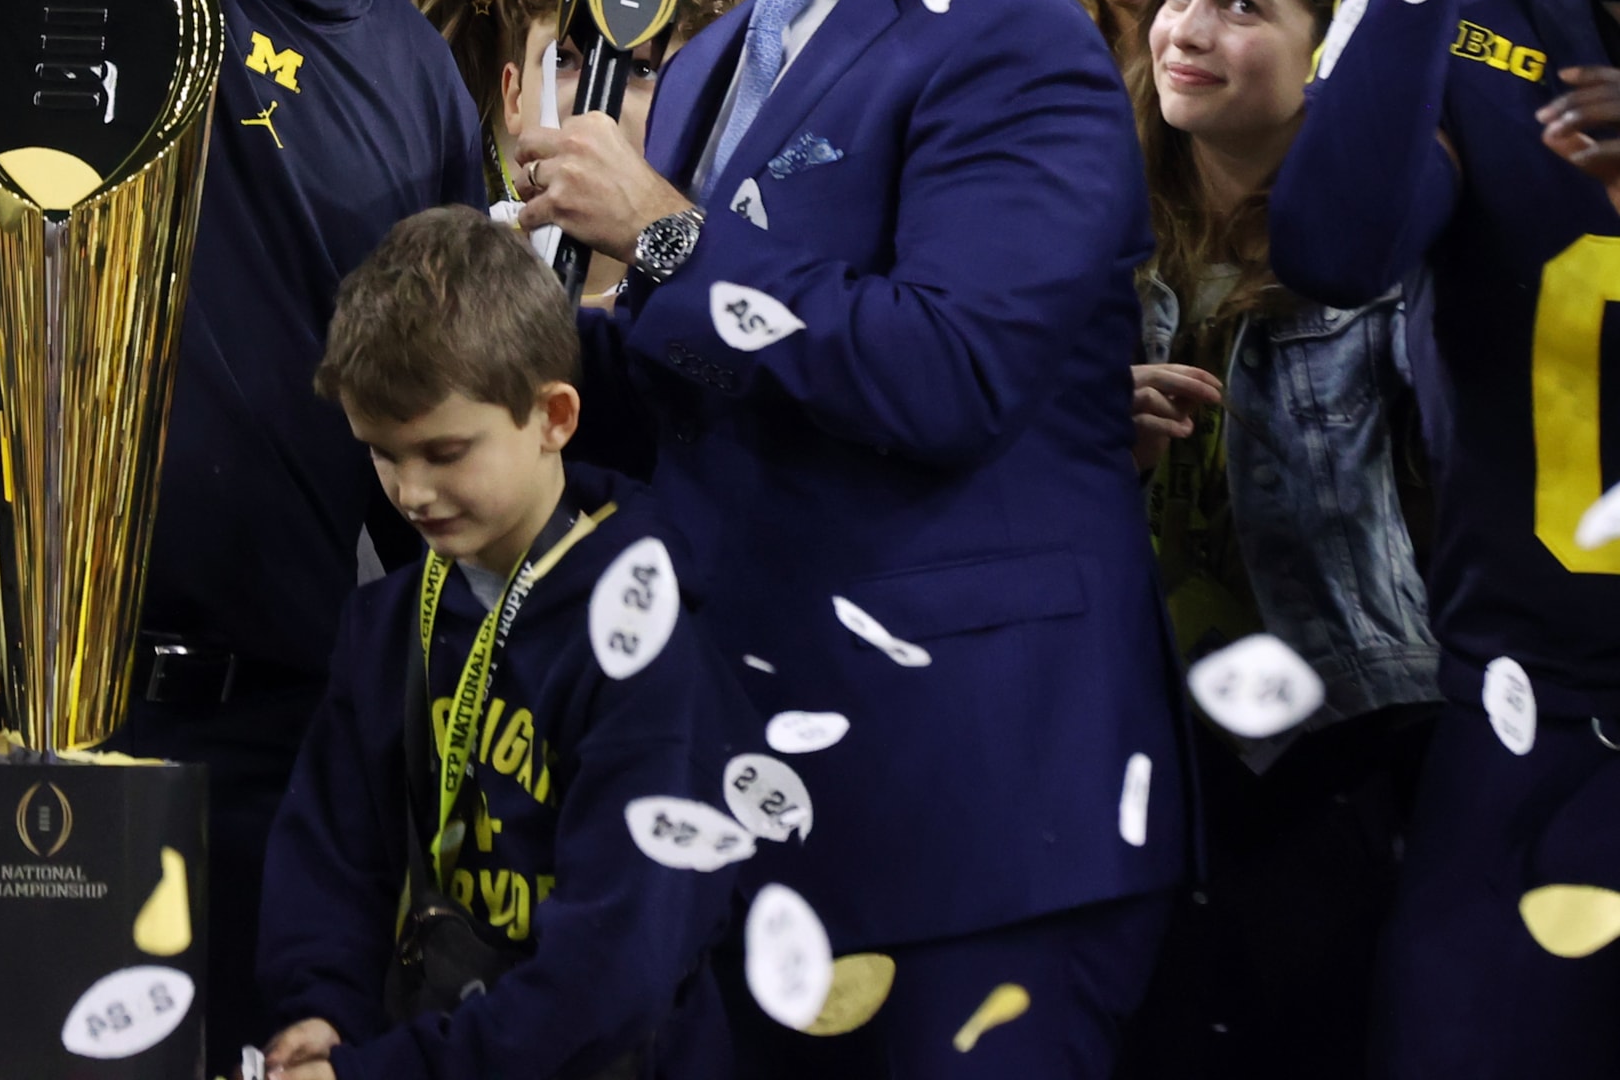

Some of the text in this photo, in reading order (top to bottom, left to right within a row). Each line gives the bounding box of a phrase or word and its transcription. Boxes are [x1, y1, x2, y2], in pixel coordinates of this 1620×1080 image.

[245, 30, 304, 92] M
[451, 645, 486, 750] NATIONAL
[0, 864, 86, 881] NATIONAL
